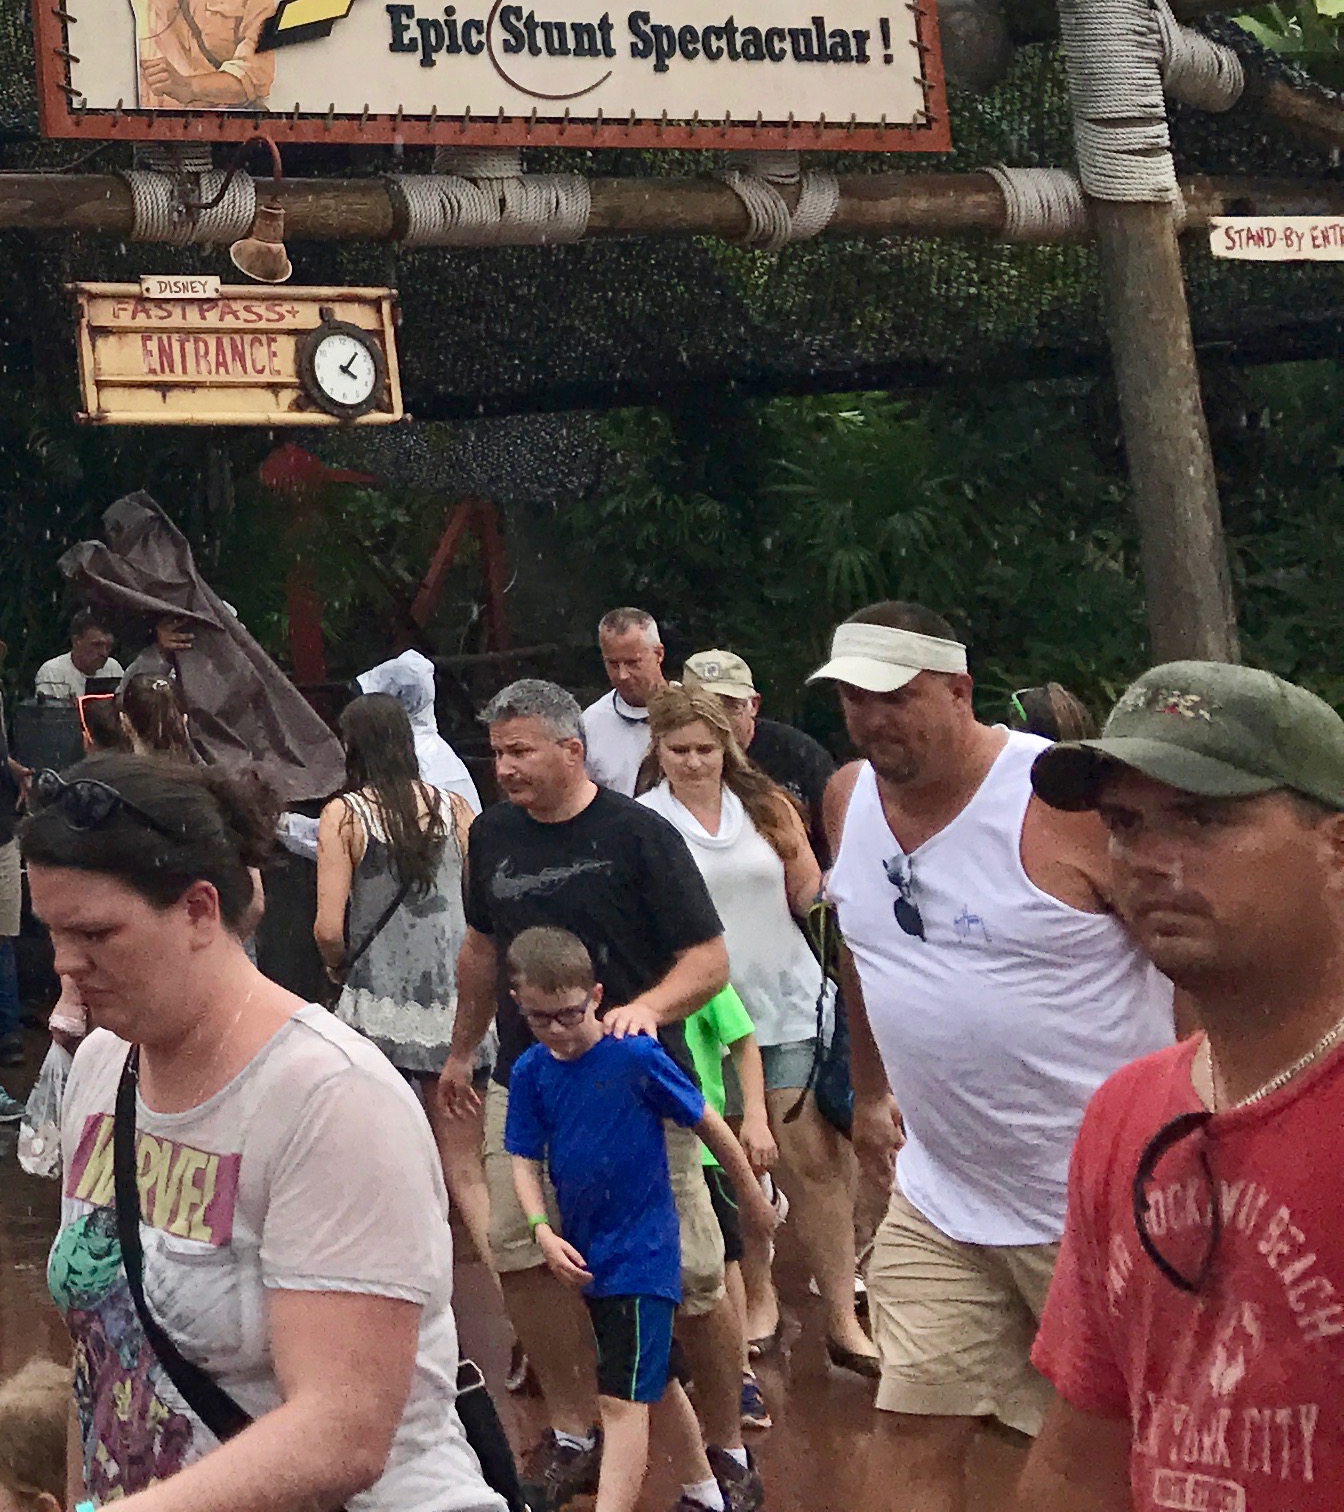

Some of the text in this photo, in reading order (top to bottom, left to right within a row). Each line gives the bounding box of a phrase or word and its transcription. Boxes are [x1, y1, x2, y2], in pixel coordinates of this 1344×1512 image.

[386, 3, 486, 68] Epic
[499, 5, 616, 58] Stunt
[1224, 224, 1305, 252] STAND-BY
[157, 279, 209, 295] DISNEY
[140, 334, 282, 377] ENTRANCE
[74, 1114, 221, 1242] MRVEL
[1242, 1403, 1319, 1482] CITY
